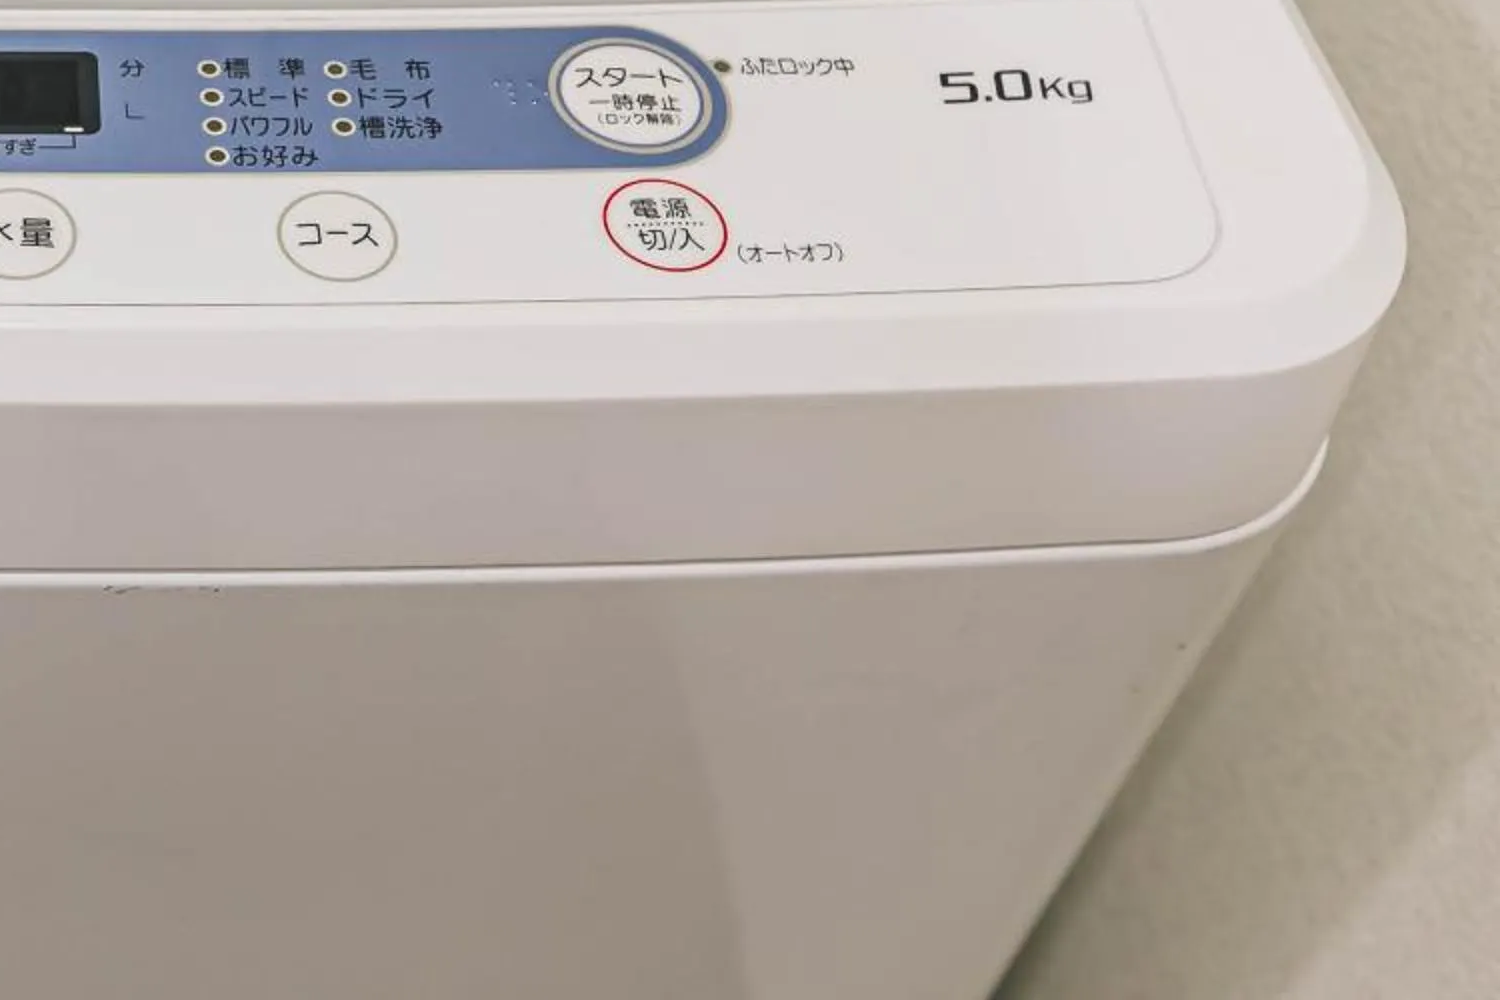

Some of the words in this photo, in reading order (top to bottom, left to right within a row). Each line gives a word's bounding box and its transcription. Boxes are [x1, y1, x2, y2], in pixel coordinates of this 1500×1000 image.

[120, 60, 144, 77] 分
[575, 67, 684, 88] スタート
[741, 58, 854, 76] ふたロック中
[229, 87, 308, 108] スピード
[358, 88, 433, 108] ドライ
[589, 94, 681, 112] 一時停止
[231, 116, 312, 136] パワフル
[359, 116, 443, 139] 槽洗浄
[233, 145, 319, 168] お好み
[630, 198, 691, 219] 電源
[294, 222, 379, 247] コース
[638, 228, 705, 251] 切/入
